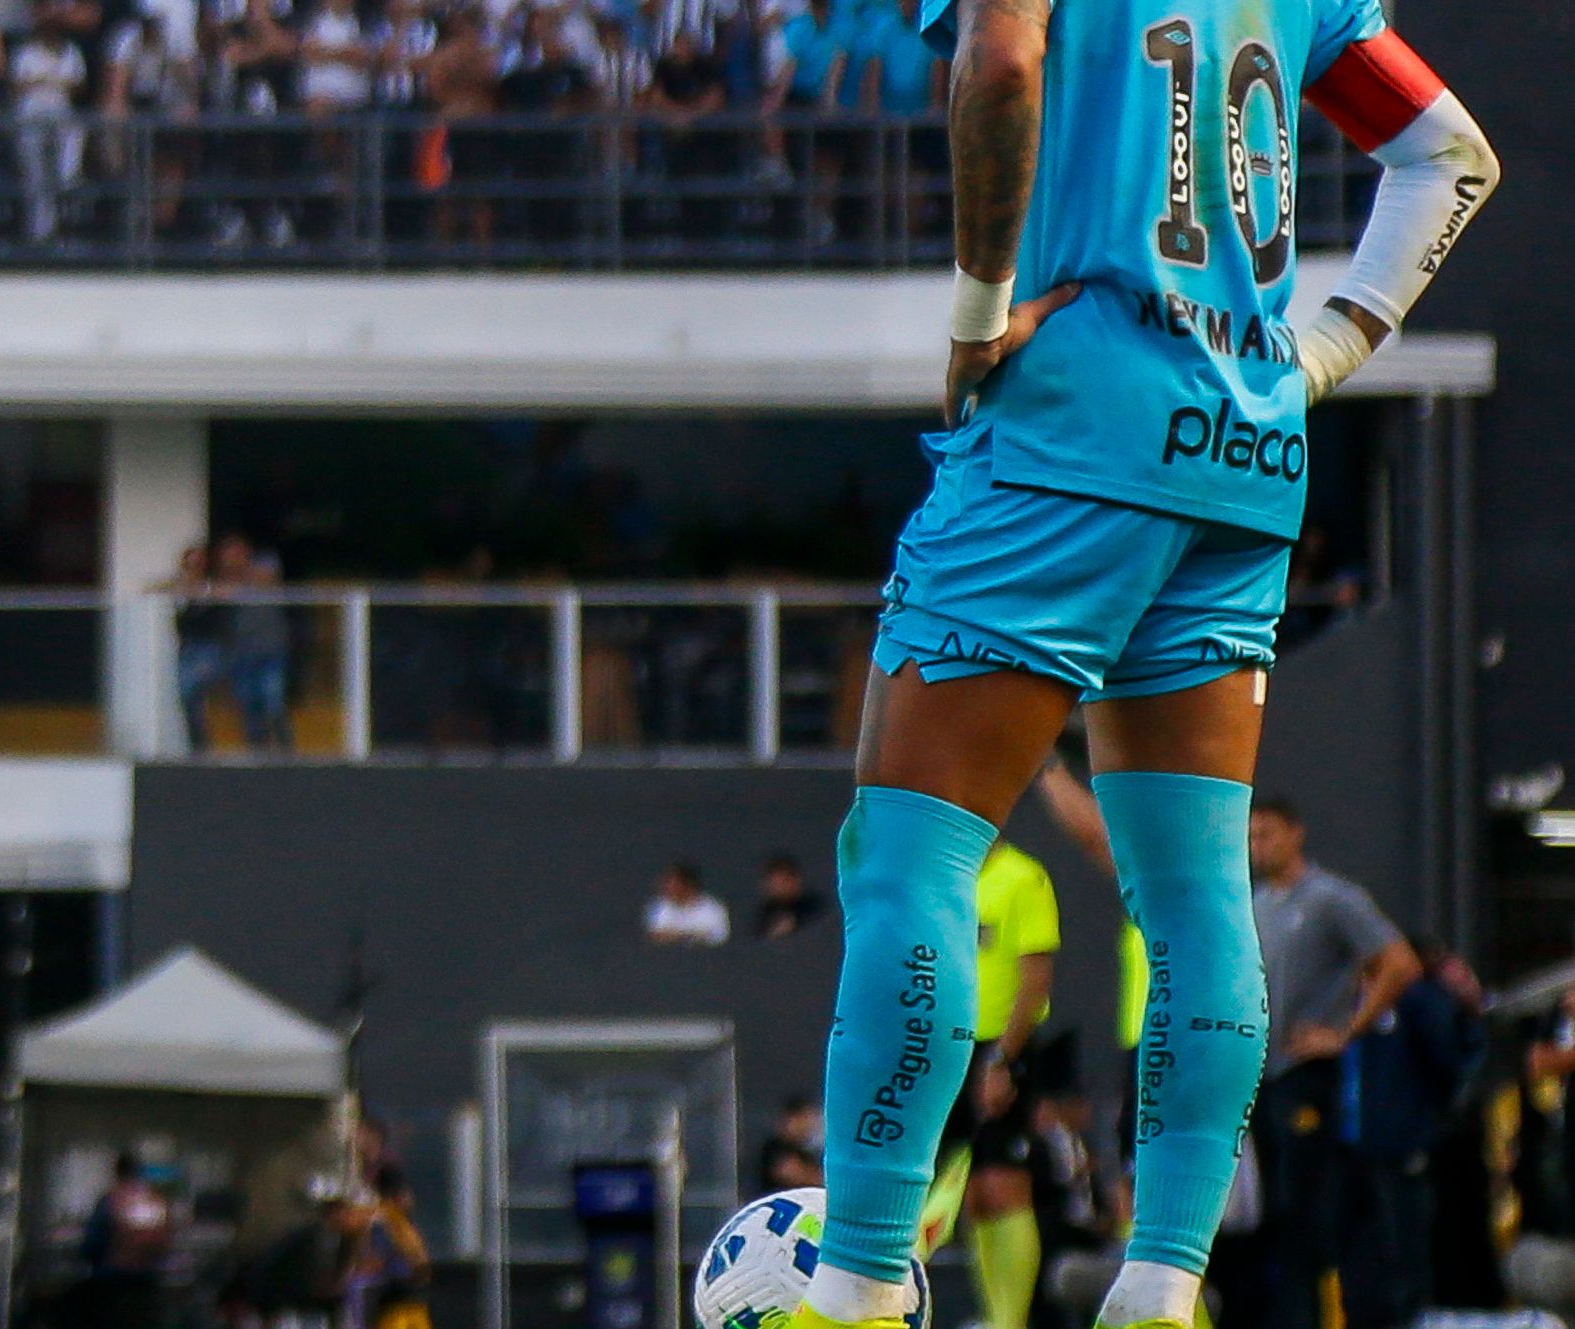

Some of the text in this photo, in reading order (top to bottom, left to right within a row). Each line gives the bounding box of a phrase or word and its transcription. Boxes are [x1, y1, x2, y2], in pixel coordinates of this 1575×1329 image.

[1144, 18, 1296, 286] 10
[1422, 175, 1487, 274] UNIKKA
[1162, 398, 1305, 483] placo
[875, 944, 938, 1109] Pague Safe
[1142, 940, 1175, 1108] Pague Safe
[1190, 1017, 1256, 1038] SFC
